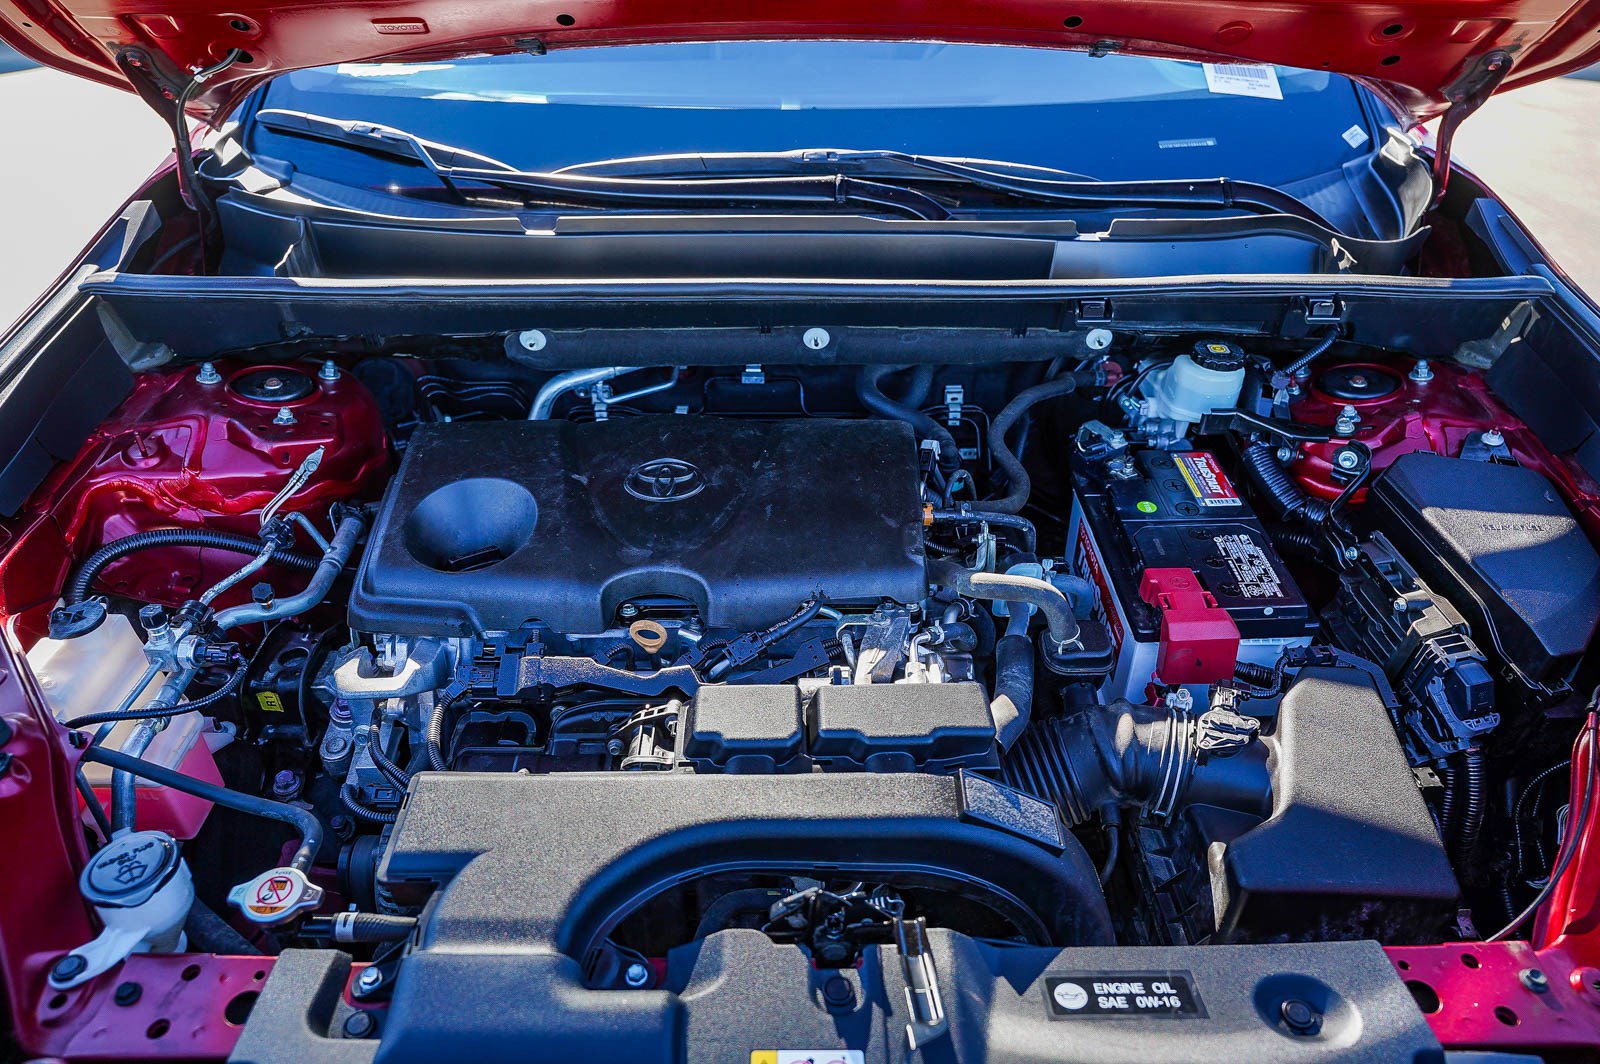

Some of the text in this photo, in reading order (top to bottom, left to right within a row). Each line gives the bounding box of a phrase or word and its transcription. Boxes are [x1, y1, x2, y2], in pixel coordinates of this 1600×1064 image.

[1093, 982, 1177, 994] ENGINE OIL
[1098, 996, 1181, 1008] SAE 0W-16
